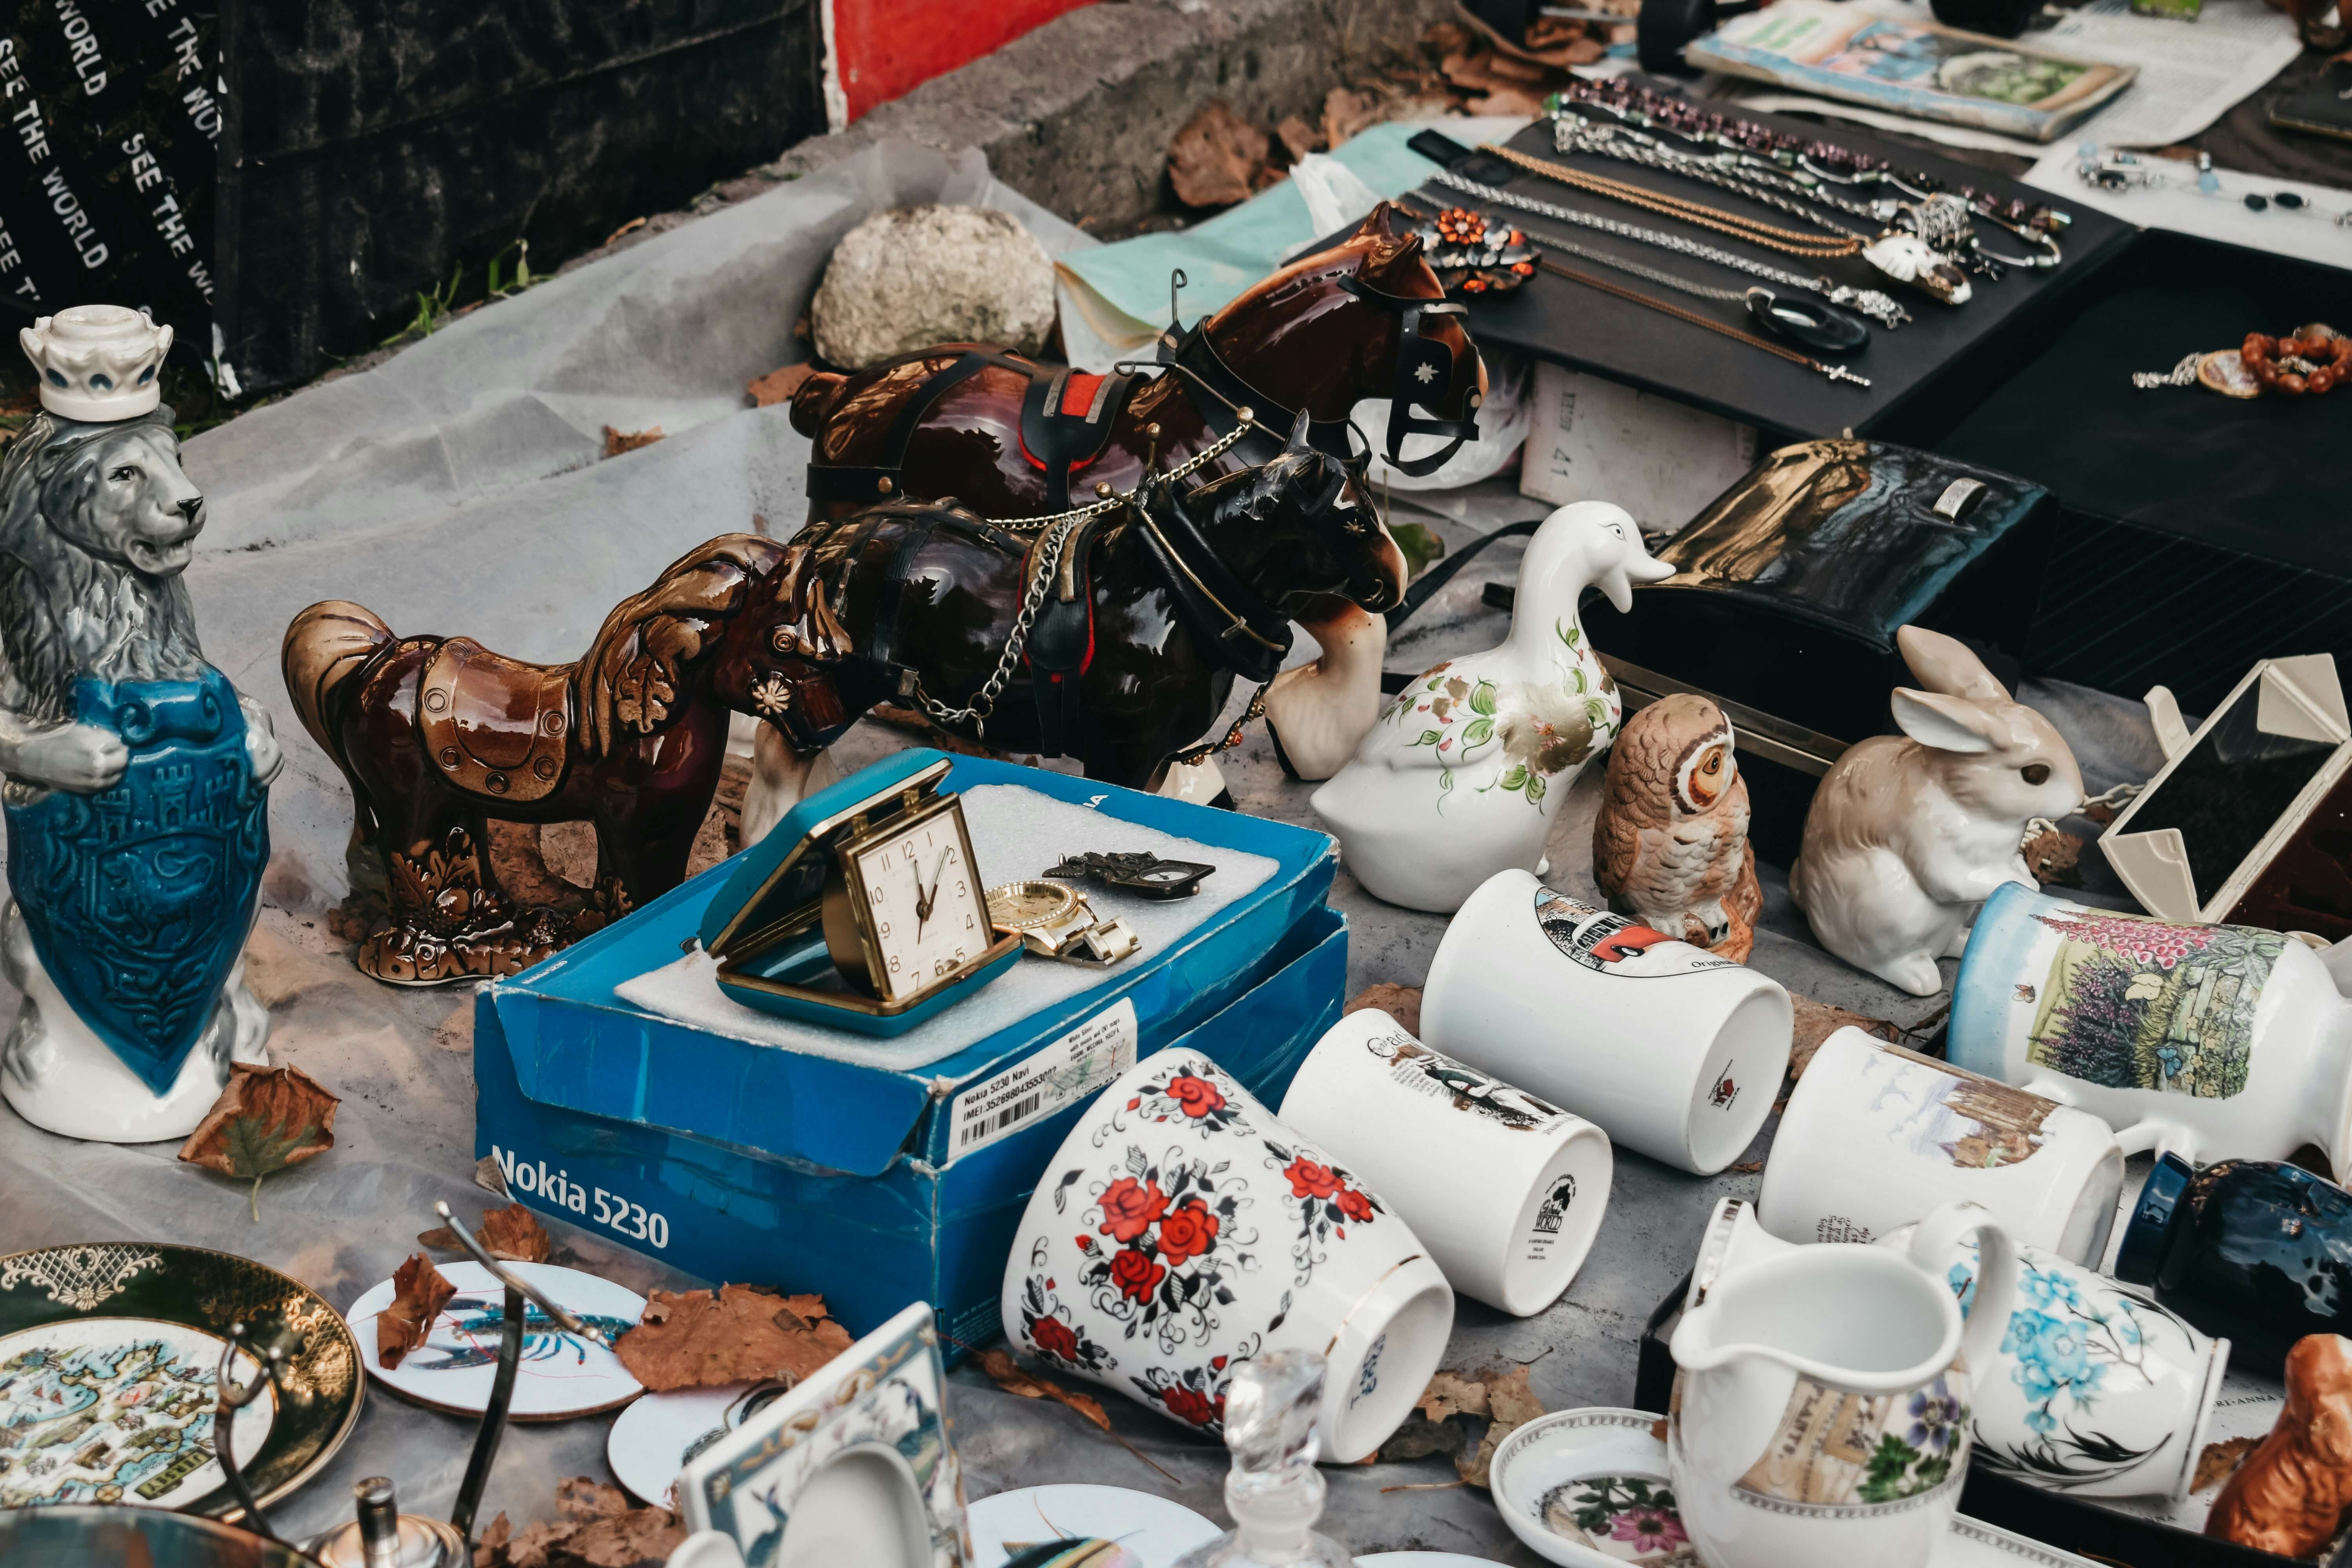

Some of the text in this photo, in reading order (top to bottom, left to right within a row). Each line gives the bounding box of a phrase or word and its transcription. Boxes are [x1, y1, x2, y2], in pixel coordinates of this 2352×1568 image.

[168, 17, 203, 82] THE
[13, 100, 50, 164] THE
[42, 167, 109, 269] WORLD
[122, 132, 194, 258] SEE THE
[0, 216, 22, 272] EE
[927, 831, 932, 847] 1
[902, 841, 915, 860] 12
[947, 848, 957, 864] 2
[881, 853, 891, 872] 11
[869, 886, 884, 906] 10
[956, 880, 966, 897] 3
[881, 922, 891, 938] 9
[966, 914, 974, 930] 4
[890, 955, 901, 973] 8
[955, 947, 965, 964] 5
[935, 959, 944, 976] 6
[911, 971, 920, 991] 7
[964, 1064, 1030, 1107] Nokia 5230 Navi
[492, 1145, 669, 1249] Nokia 5230
[1535, 1215, 1563, 1230] WORLD
[147, 1454, 203, 1492] JERSEY
